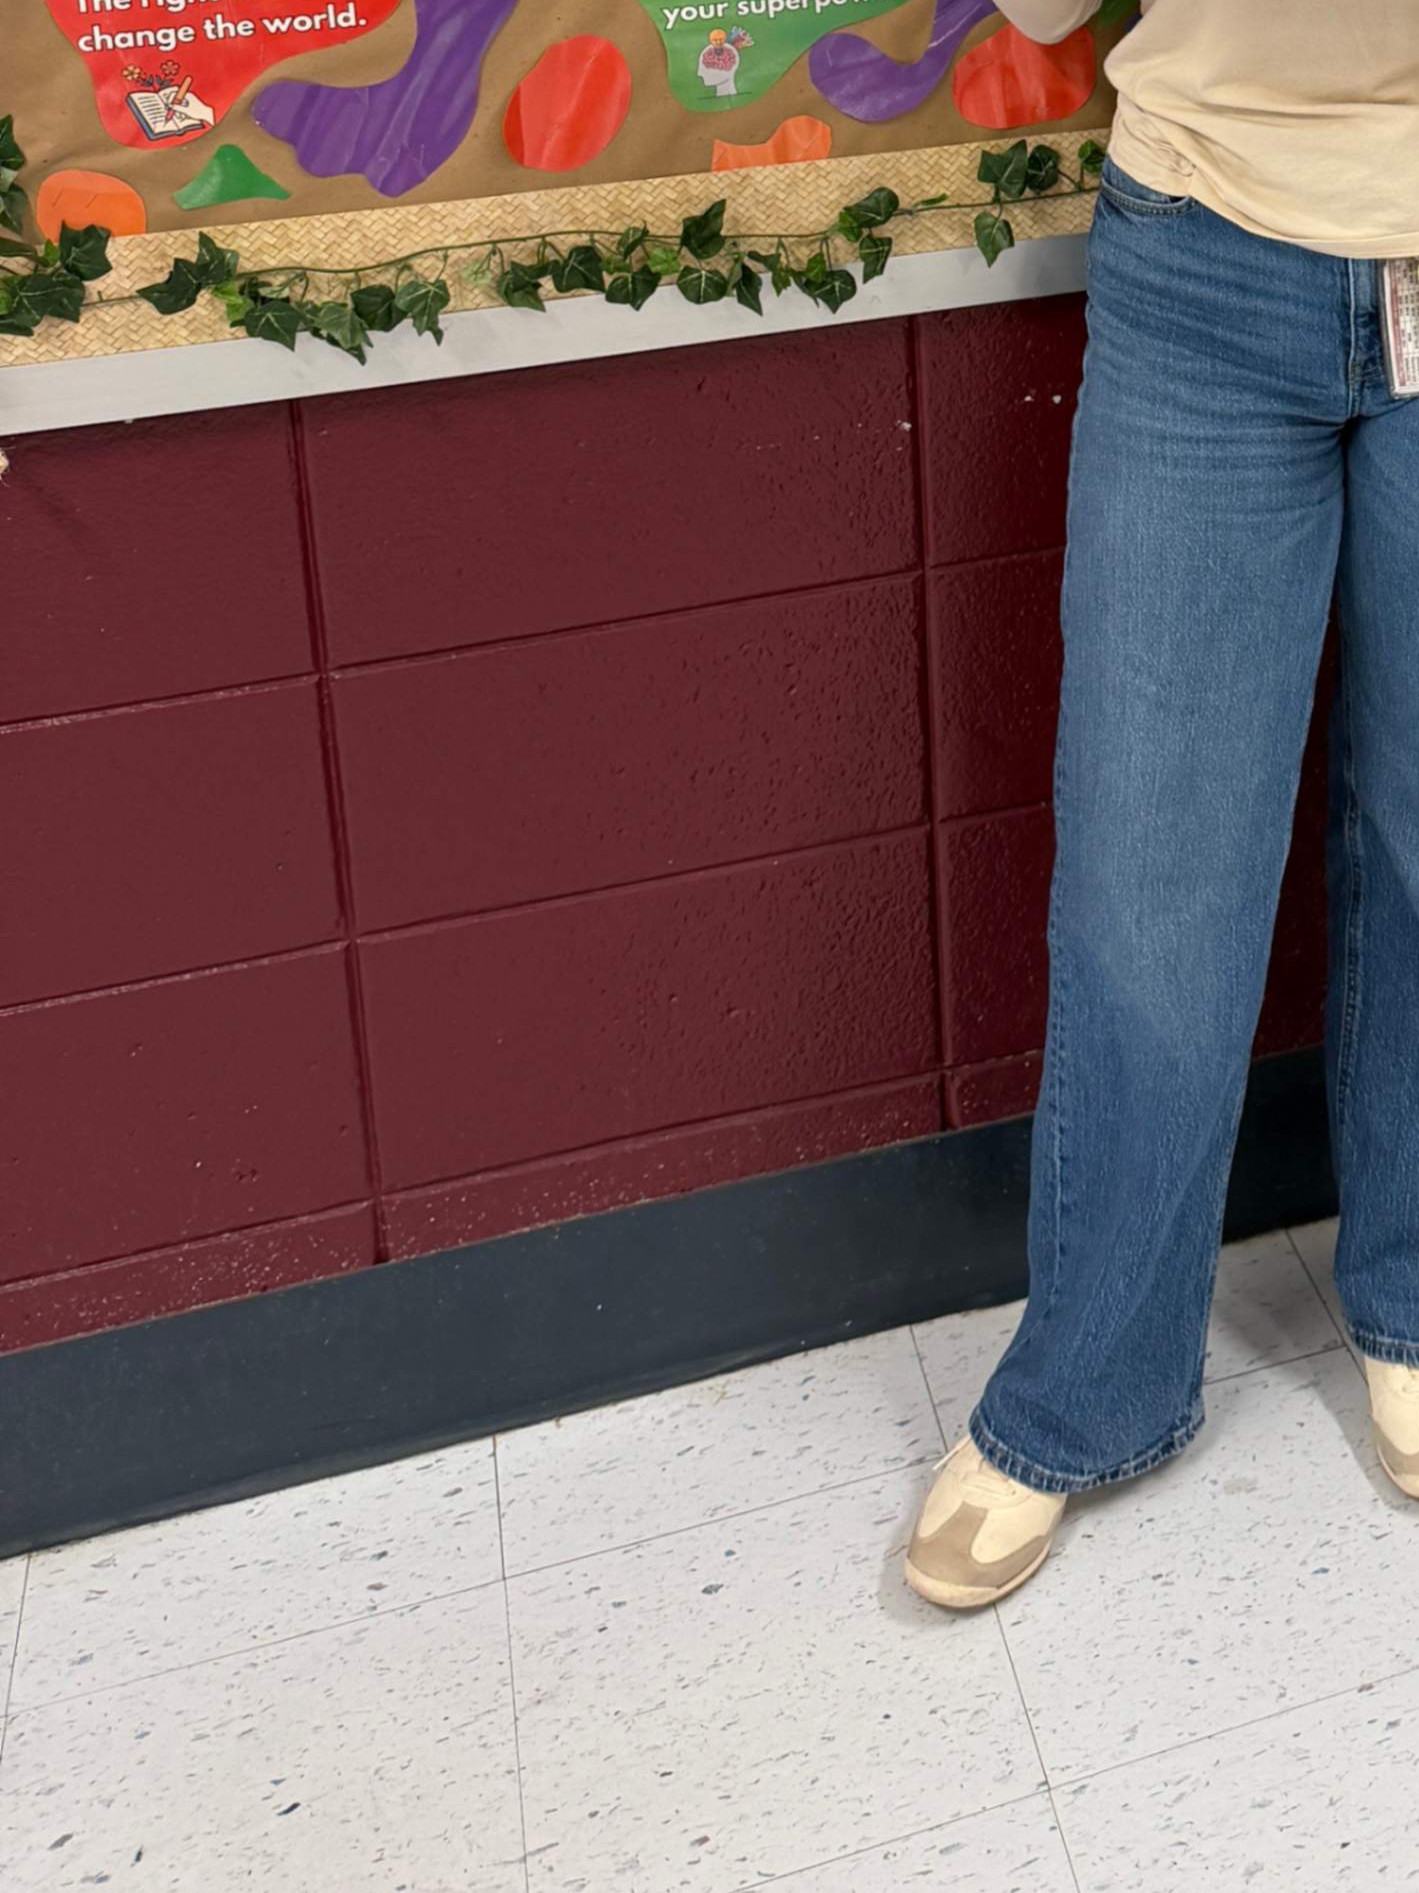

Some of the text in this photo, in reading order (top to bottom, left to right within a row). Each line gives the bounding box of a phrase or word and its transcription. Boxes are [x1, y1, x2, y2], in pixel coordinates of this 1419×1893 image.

[77, 2, 368, 52] change the world.
[662, 1, 728, 30] your
